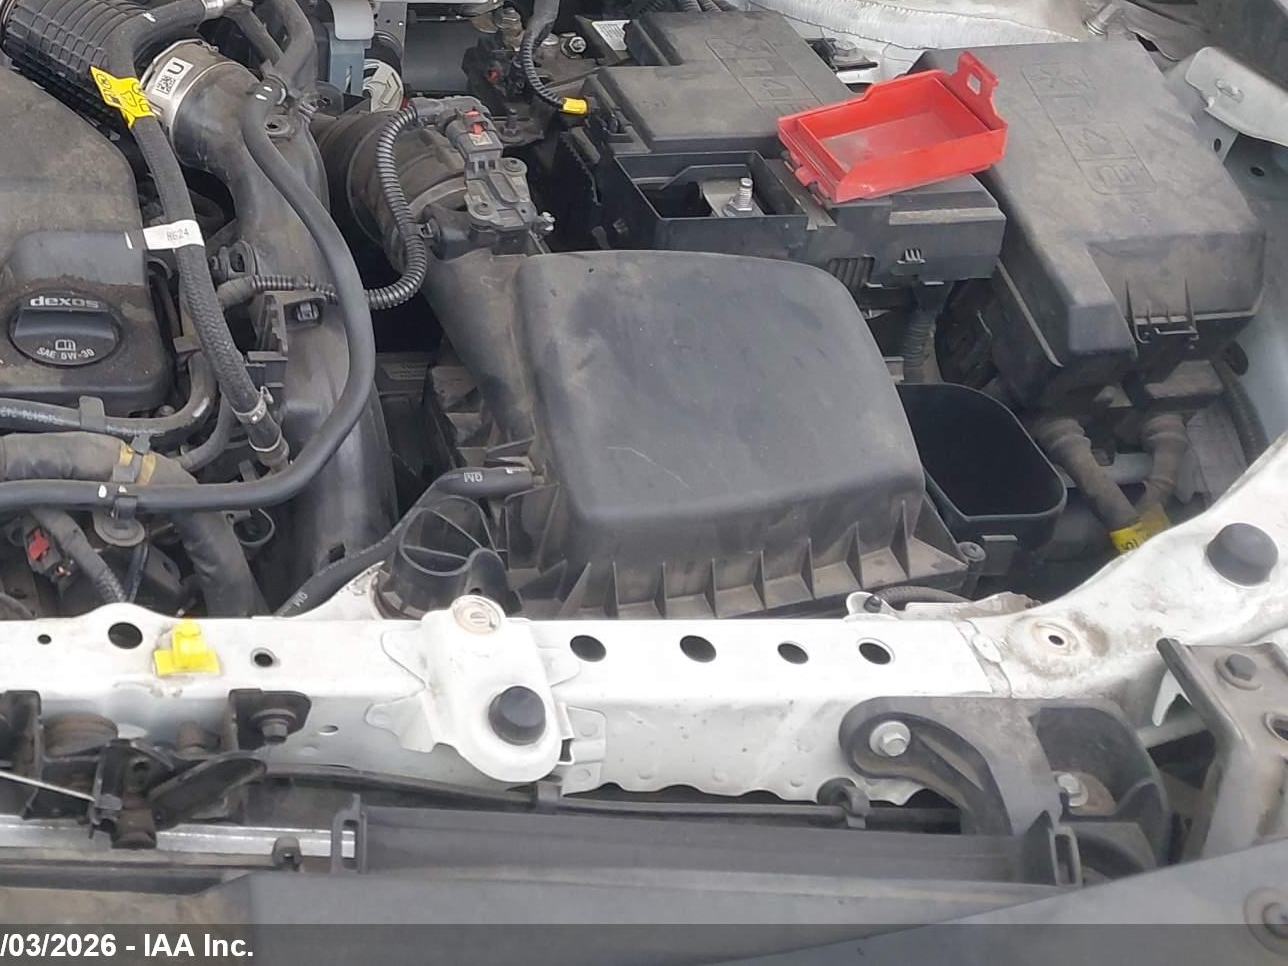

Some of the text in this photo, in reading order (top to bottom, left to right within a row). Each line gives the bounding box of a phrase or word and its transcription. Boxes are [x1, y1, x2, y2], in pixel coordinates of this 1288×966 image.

[167, 61, 185, 75] U
[30, 296, 99, 309] dexos
[37, 347, 56, 359] SAE
